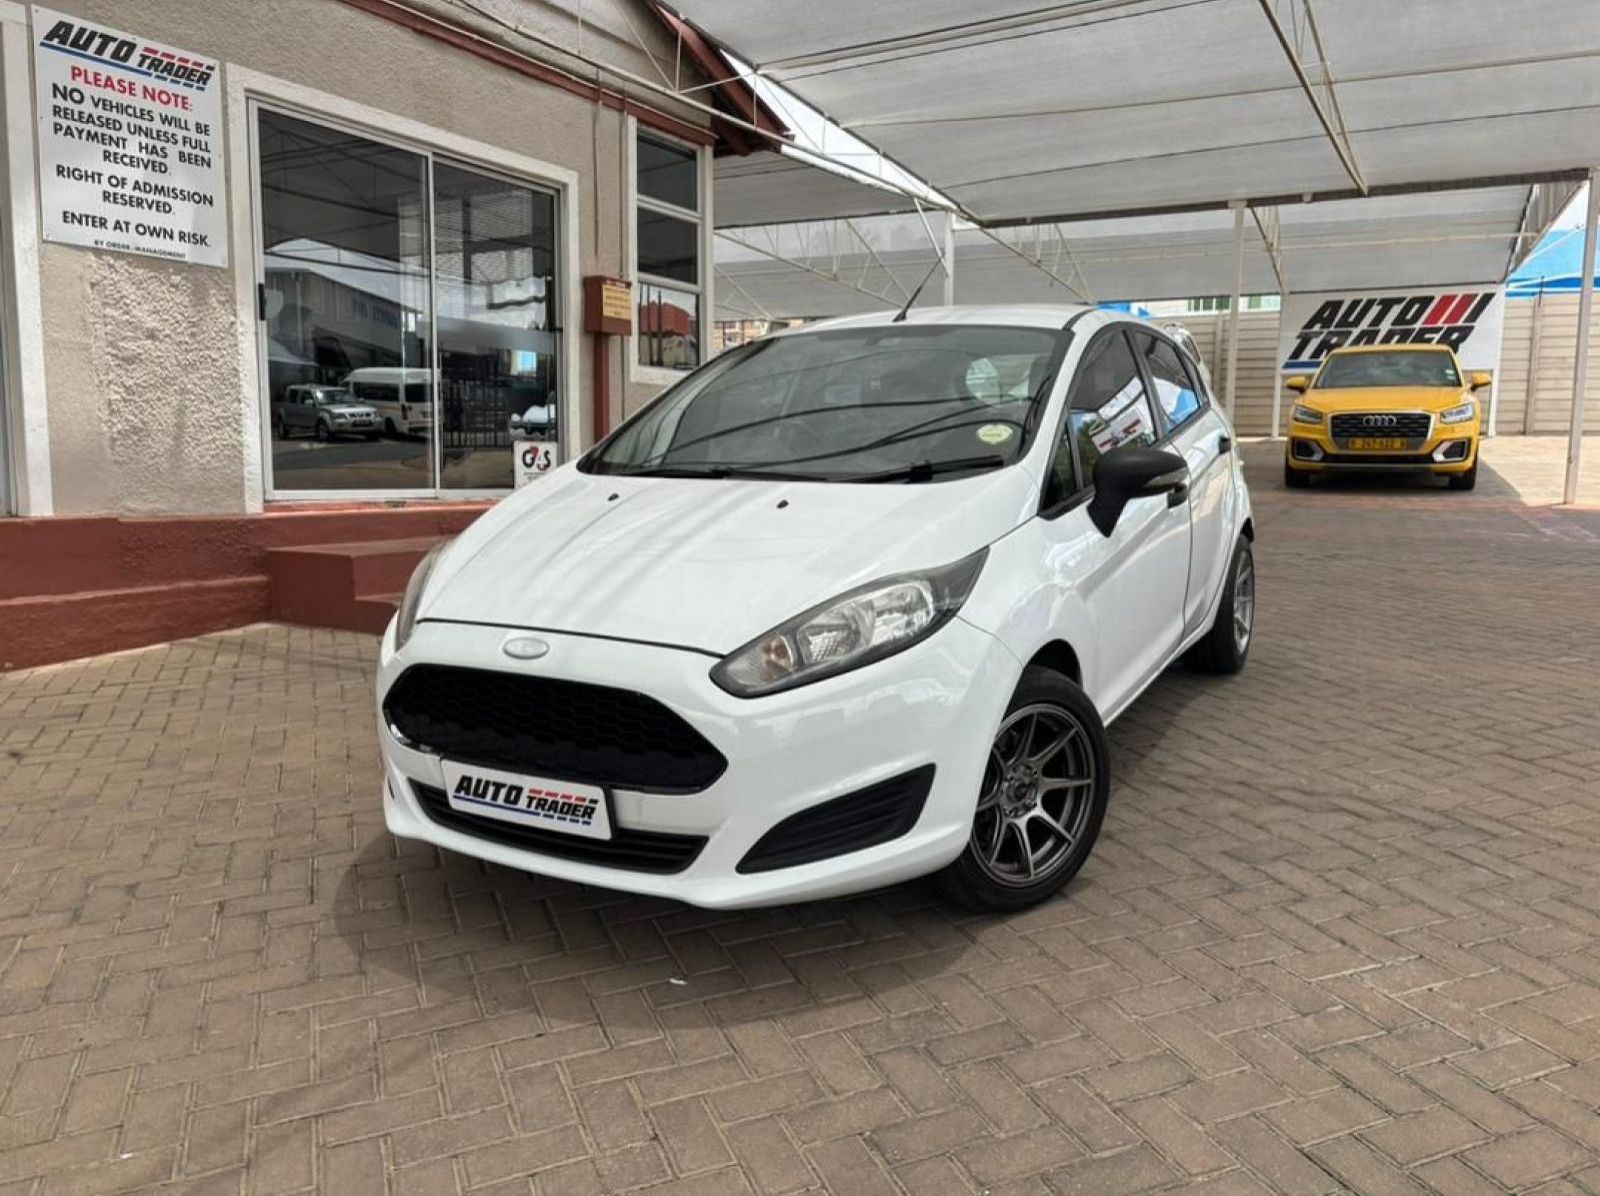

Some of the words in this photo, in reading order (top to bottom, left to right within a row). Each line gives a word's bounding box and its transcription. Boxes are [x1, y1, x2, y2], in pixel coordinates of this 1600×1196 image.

[43, 20, 138, 62] AUTO
[137, 53, 212, 86] TRADER
[71, 65, 136, 96] PLEASE
[52, 83, 84, 104] NO
[90, 95, 154, 122] VEHICLES
[158, 112, 190, 132] WILL
[194, 123, 210, 136] BE
[53, 105, 122, 131] RELEASED
[127, 123, 178, 145] UNLESS
[182, 135, 211, 153] FULL
[53, 122, 127, 149] PAYMENT
[138, 141, 168, 158] HAS
[179, 151, 211, 169] BEEN
[56, 164, 103, 185] RIGHT
[108, 175, 128, 189] OF
[132, 179, 213, 207] ADMISSION
[62, 211, 108, 230] ENTER
[113, 219, 130, 233] AT
[135, 223, 174, 240] OWN
[1301, 295, 1436, 330] AUTO
[454, 775, 524, 806] AUTO
[525, 795, 596, 820] TRADER
